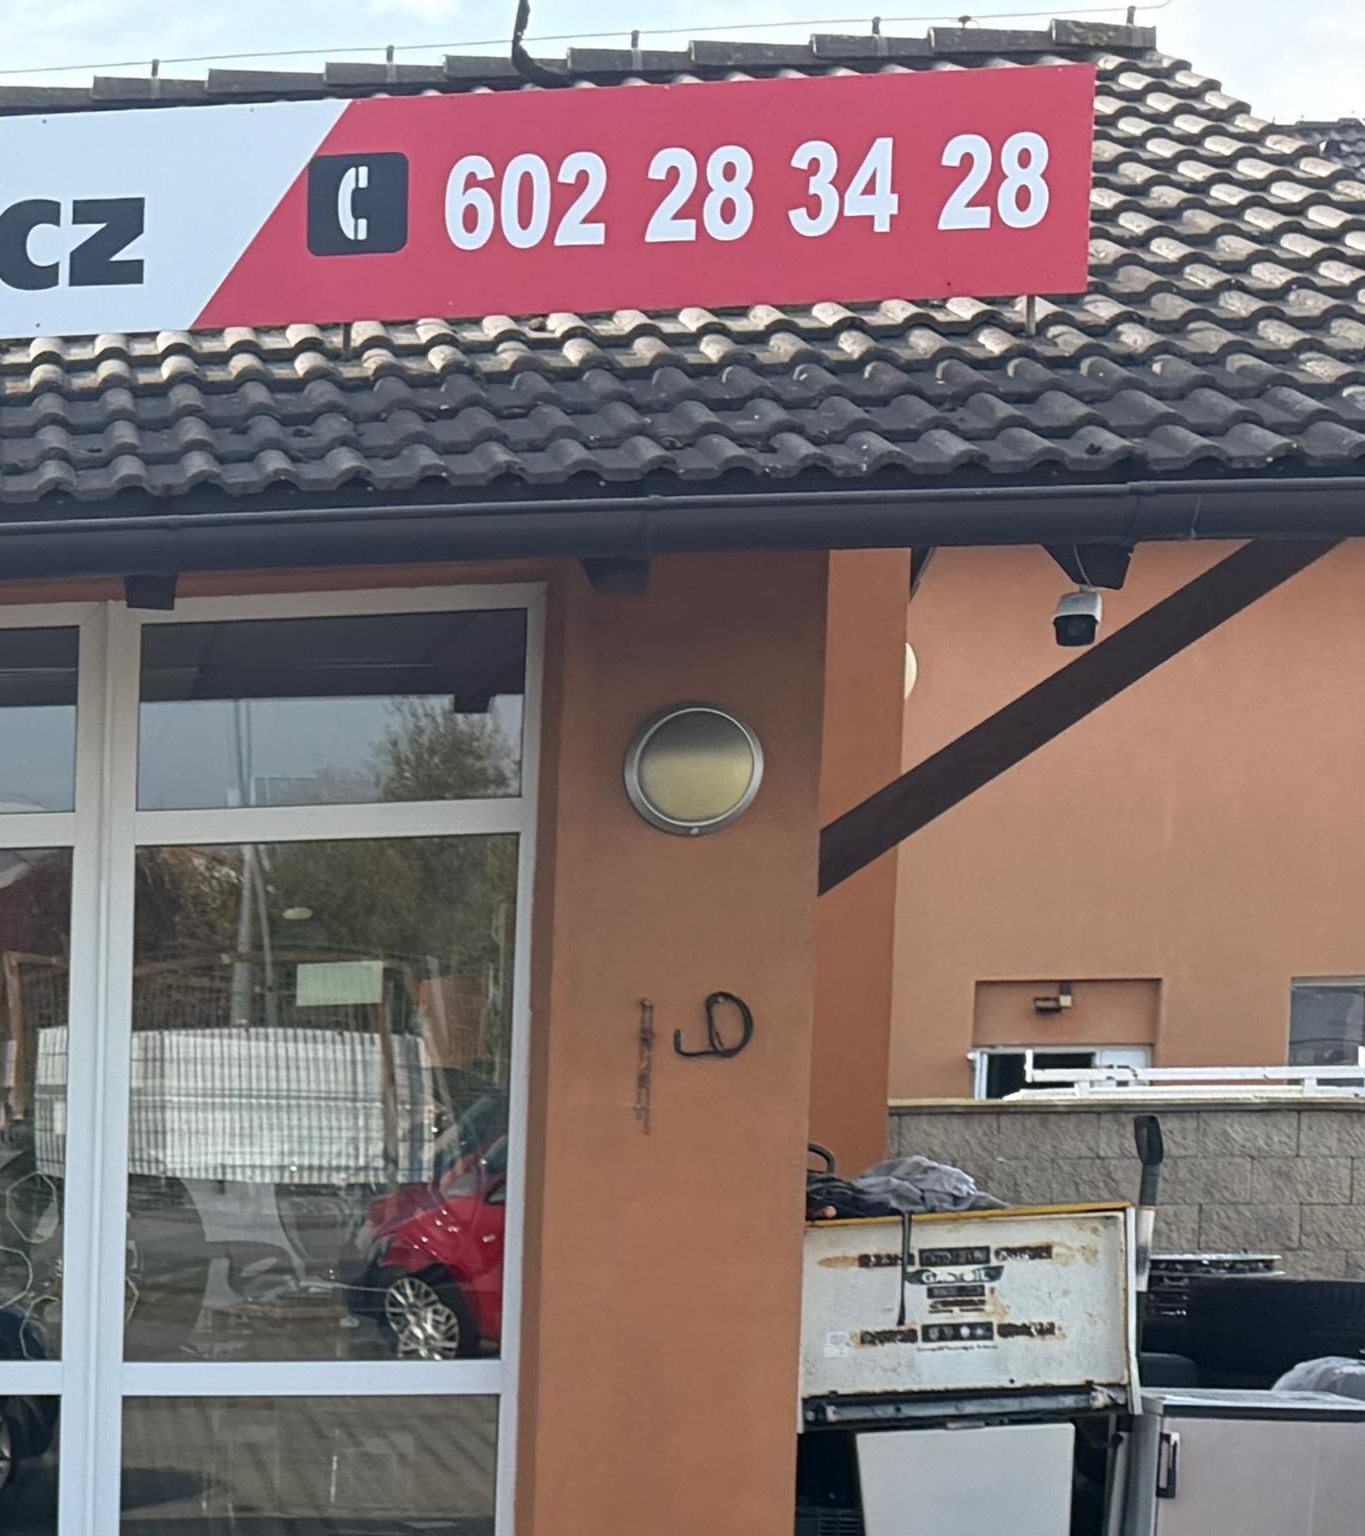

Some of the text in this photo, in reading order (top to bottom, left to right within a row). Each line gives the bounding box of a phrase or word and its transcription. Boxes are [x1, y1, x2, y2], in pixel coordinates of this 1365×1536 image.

[444, 131, 1050, 250] 602 28 34 28
